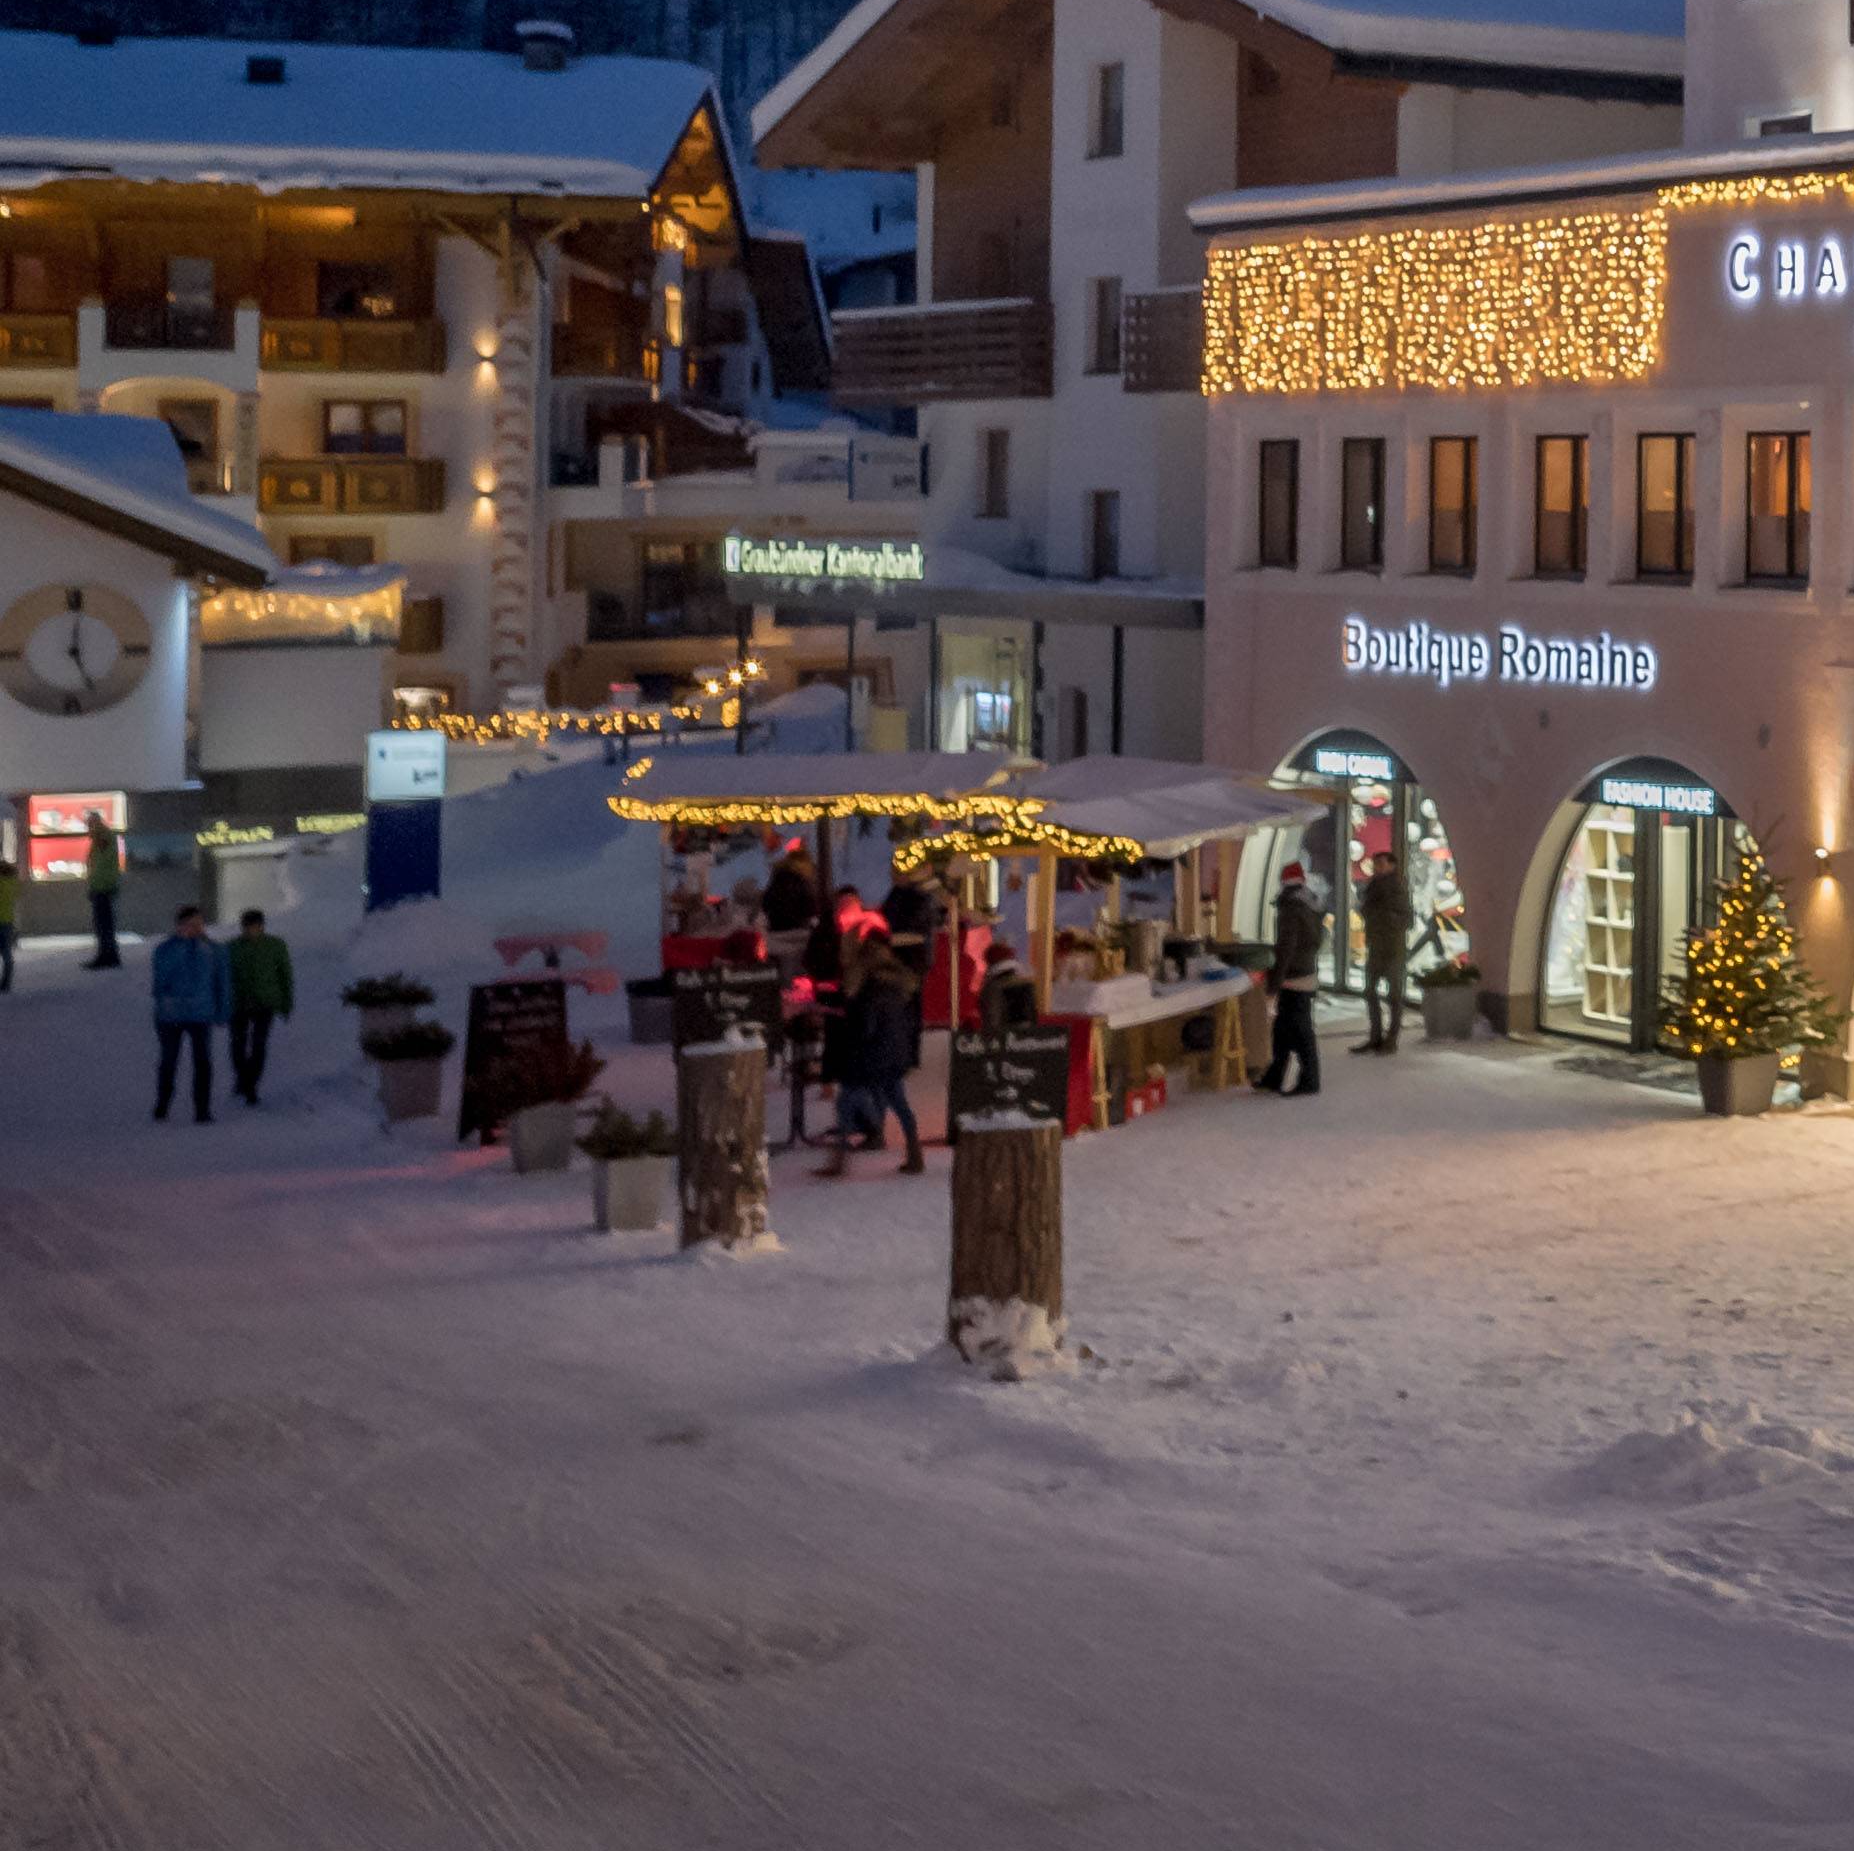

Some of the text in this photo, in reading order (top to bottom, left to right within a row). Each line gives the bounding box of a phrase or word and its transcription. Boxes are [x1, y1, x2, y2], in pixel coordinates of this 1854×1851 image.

[1343, 618, 1656, 691] Boutique Romaine
[1602, 778, 1715, 815] FASHION HOUSE
